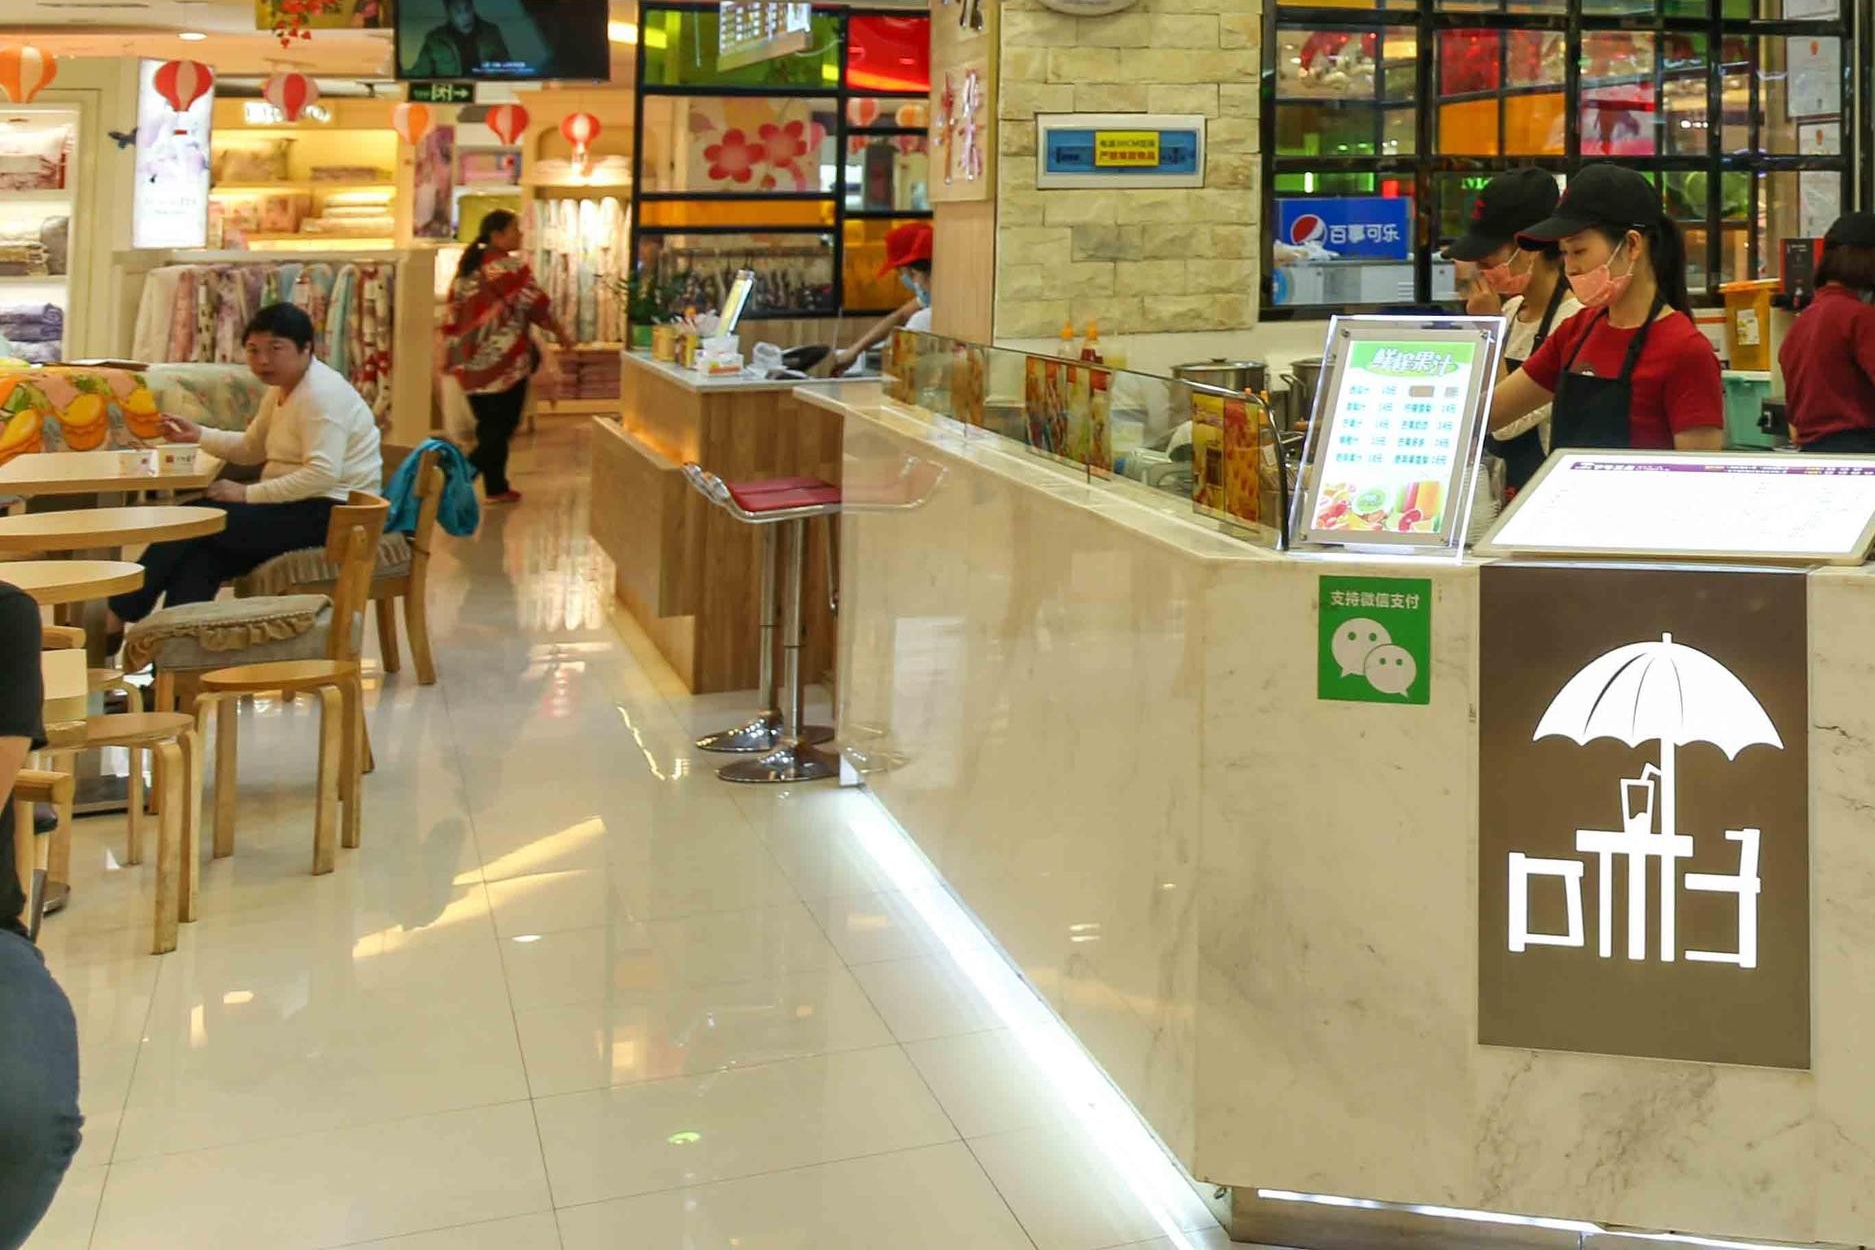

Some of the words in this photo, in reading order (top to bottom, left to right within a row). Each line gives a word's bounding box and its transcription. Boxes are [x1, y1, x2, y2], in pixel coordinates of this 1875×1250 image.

[1329, 223, 1401, 245] 百事可乐
[1330, 589, 1420, 610] 支持微信支付
